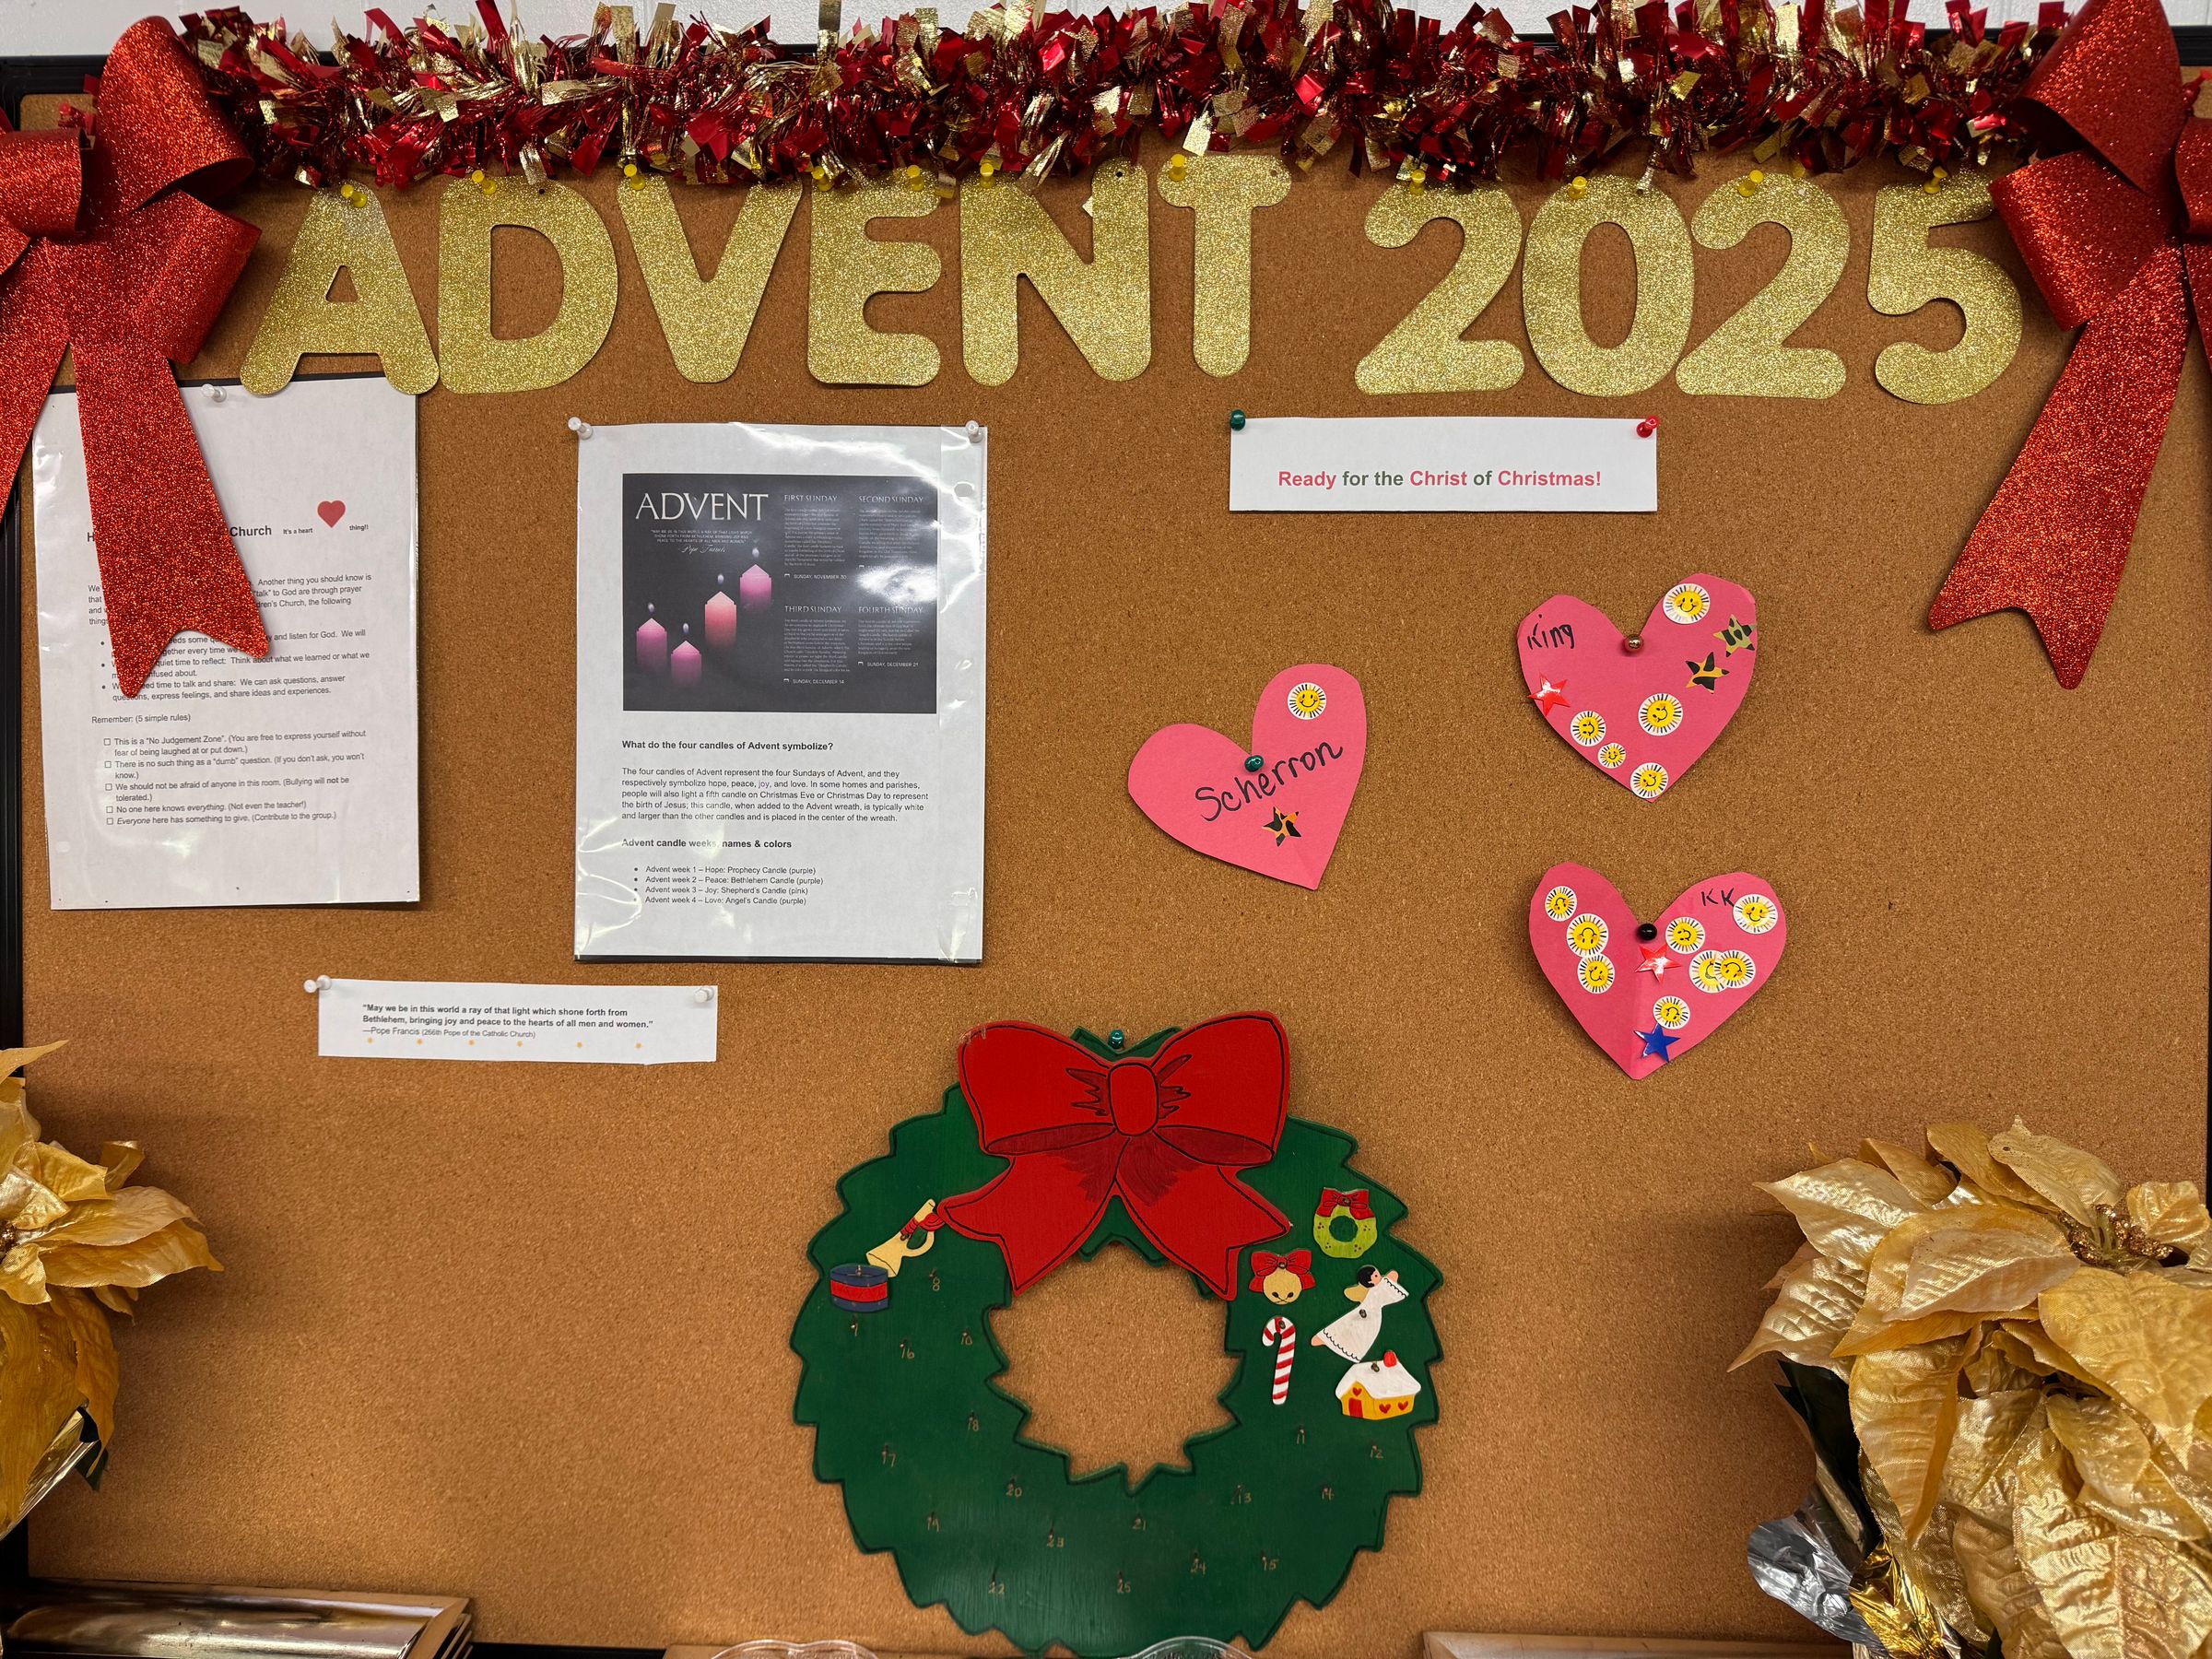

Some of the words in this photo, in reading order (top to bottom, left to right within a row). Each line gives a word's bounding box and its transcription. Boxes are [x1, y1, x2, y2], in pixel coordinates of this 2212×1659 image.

[240, 154, 1291, 395] ADVENT
[1354, 171, 2024, 405] 2025
[1278, 470, 1336, 490] Ready
[1342, 471, 1368, 486] for
[1374, 471, 1404, 486] the
[1410, 470, 1467, 487] Christ
[1473, 470, 1492, 486] of
[1498, 470, 1601, 487] Christmas!
[635, 493, 769, 521] ADVENT
[230, 525, 272, 536] Church
[306, 577, 318, 585] you
[312, 586, 337, 595] through
[1526, 614, 1575, 650] King
[145, 715, 168, 724] simple
[171, 714, 191, 723] rules)
[161, 735, 201, 744] Judgement
[662, 741, 677, 749] the
[679, 741, 696, 749] four
[747, 742, 780, 750] Advent
[782, 742, 833, 751] symbolize?
[656, 768, 685, 776] candles
[724, 770, 759, 778] represent
[793, 770, 825, 778] Sundays
[837, 770, 865, 779] Advent,
[884, 771, 900, 779] they
[622, 779, 666, 788] respectively
[669, 779, 706, 788] symbolize
[708, 780, 729, 788] hope,
[732, 781, 757, 789] peace,
[758, 781, 771, 789] joy,
[886, 782, 920, 790] parishes,
[1194, 742, 1344, 822] Scherron
[705, 866, 725, 875] Hope:
[727, 867, 759, 876] Prophecy
[789, 867, 816, 877] (purple)
[420, 1005, 434, 1013] this
[512, 1006, 530, 1016] light
[363, 1016, 407, 1024] Bethlehem,
[409, 1017, 442, 1026] bringing
[444, 1018, 456, 1026] joy
[510, 1030, 535, 1039] Church)
[933, 1277, 940, 1291] 8
[901, 1346, 915, 1359] 16
[882, 1452, 897, 1467] 17
